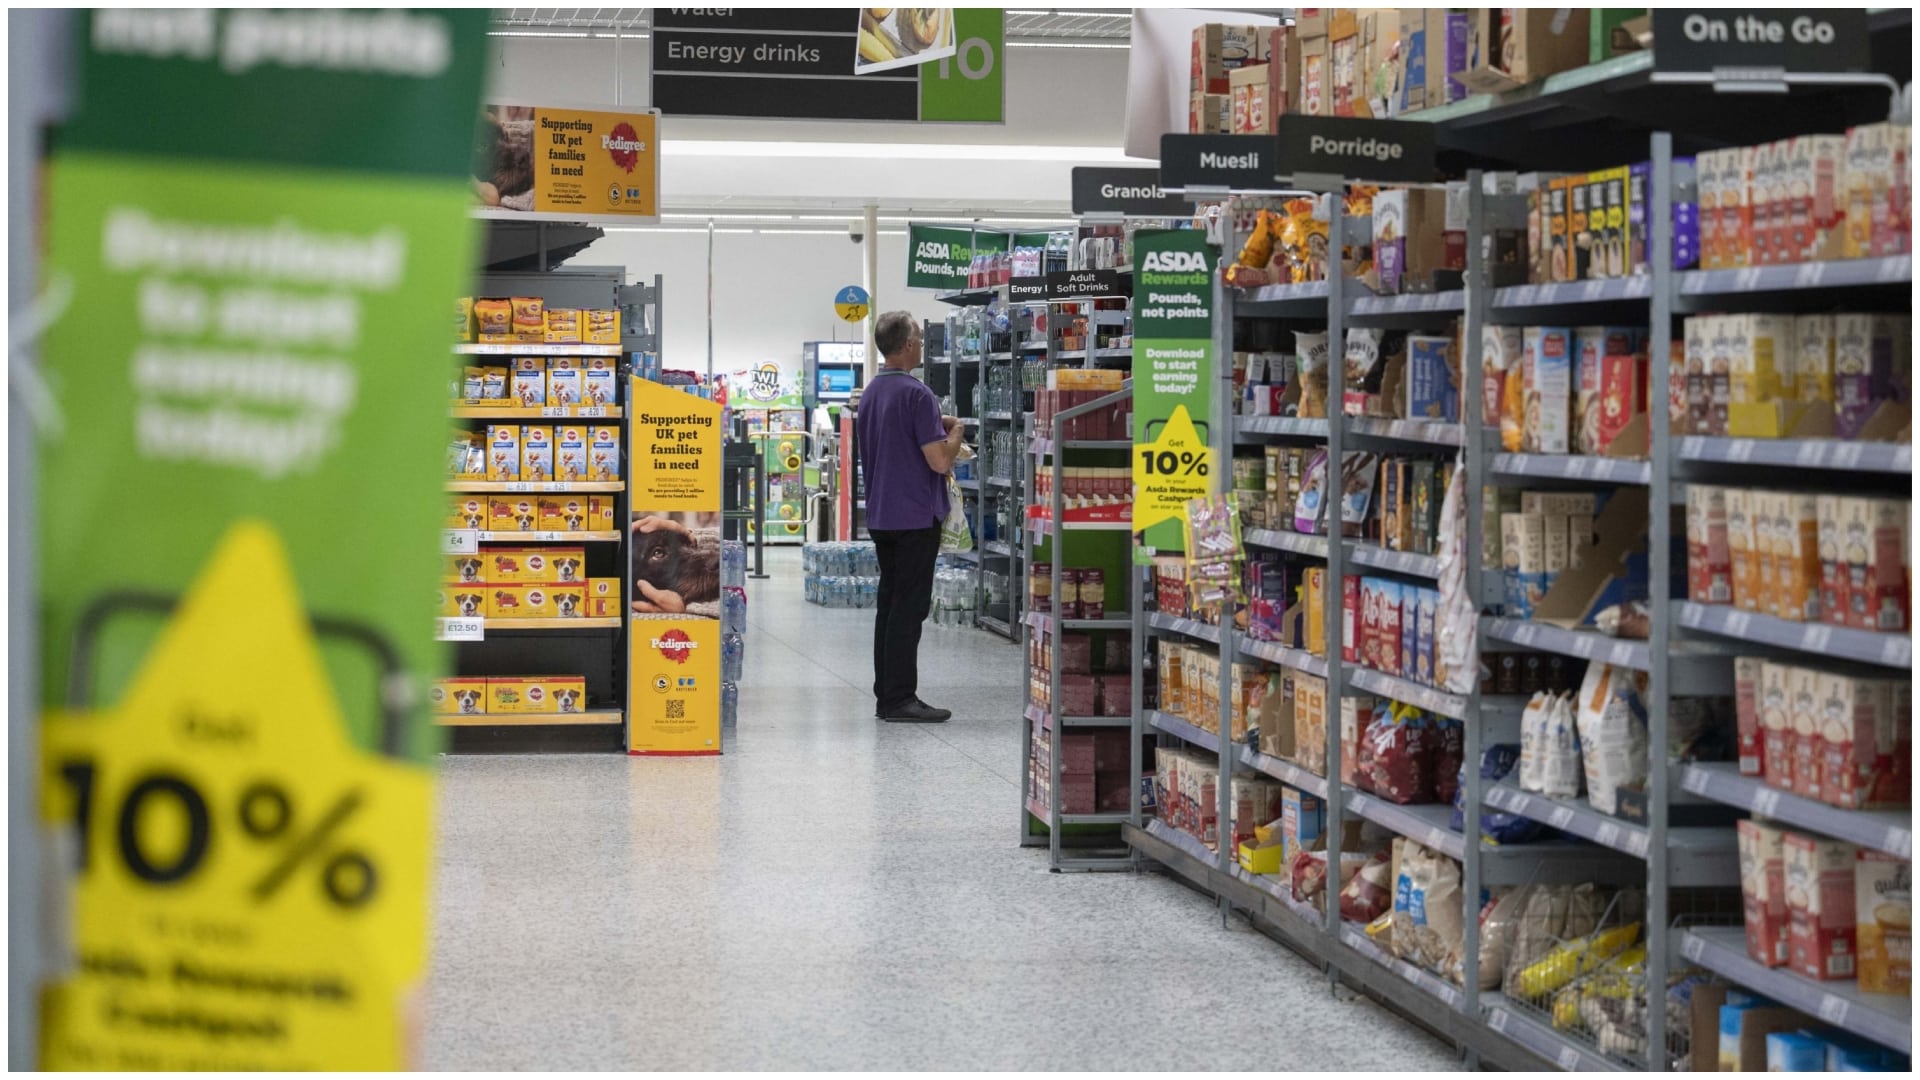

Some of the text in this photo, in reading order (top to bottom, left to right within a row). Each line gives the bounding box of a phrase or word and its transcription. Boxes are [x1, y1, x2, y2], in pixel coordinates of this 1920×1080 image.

[1683, 14, 1835, 43] On the Go
[668, 41, 821, 63] Energy drinks
[541, 117, 593, 134] Supporting
[552, 134, 583, 147] UK pet
[601, 135, 646, 154] Pedigree
[1310, 135, 1403, 160] Porridge
[548, 149, 586, 162] families
[1200, 152, 1259, 169] Muesli
[551, 164, 584, 176] in need
[1101, 183, 1166, 199] Granola
[916, 241, 950, 259] ASDA
[1141, 251, 1209, 272] ASDA
[915, 260, 970, 278] Pounds, no
[1069, 273, 1096, 282] Adult
[1141, 272, 1208, 285] Rewards
[1011, 284, 1042, 294] Energy
[1056, 284, 1076, 293] Soft
[1079, 282, 1109, 292] Drinks
[1149, 292, 1202, 305] Pounds,
[1141, 306, 1209, 319] not points
[1146, 348, 1205, 358] Download
[1153, 360, 1197, 370] to start
[1152, 372, 1198, 383] earning
[640, 413, 713, 427] Supporting
[656, 429, 698, 442] UK pet
[650, 443, 703, 455] families
[1168, 439, 1184, 447] Get
[653, 459, 699, 470] in need
[1141, 450, 1208, 477] 10%
[1146, 485, 1205, 494] Asda Rewards
[450, 536, 463, 545] £4
[447, 623, 478, 633] £12.50
[650, 638, 698, 651] Pedigree
[57, 757, 381, 912] 10%
